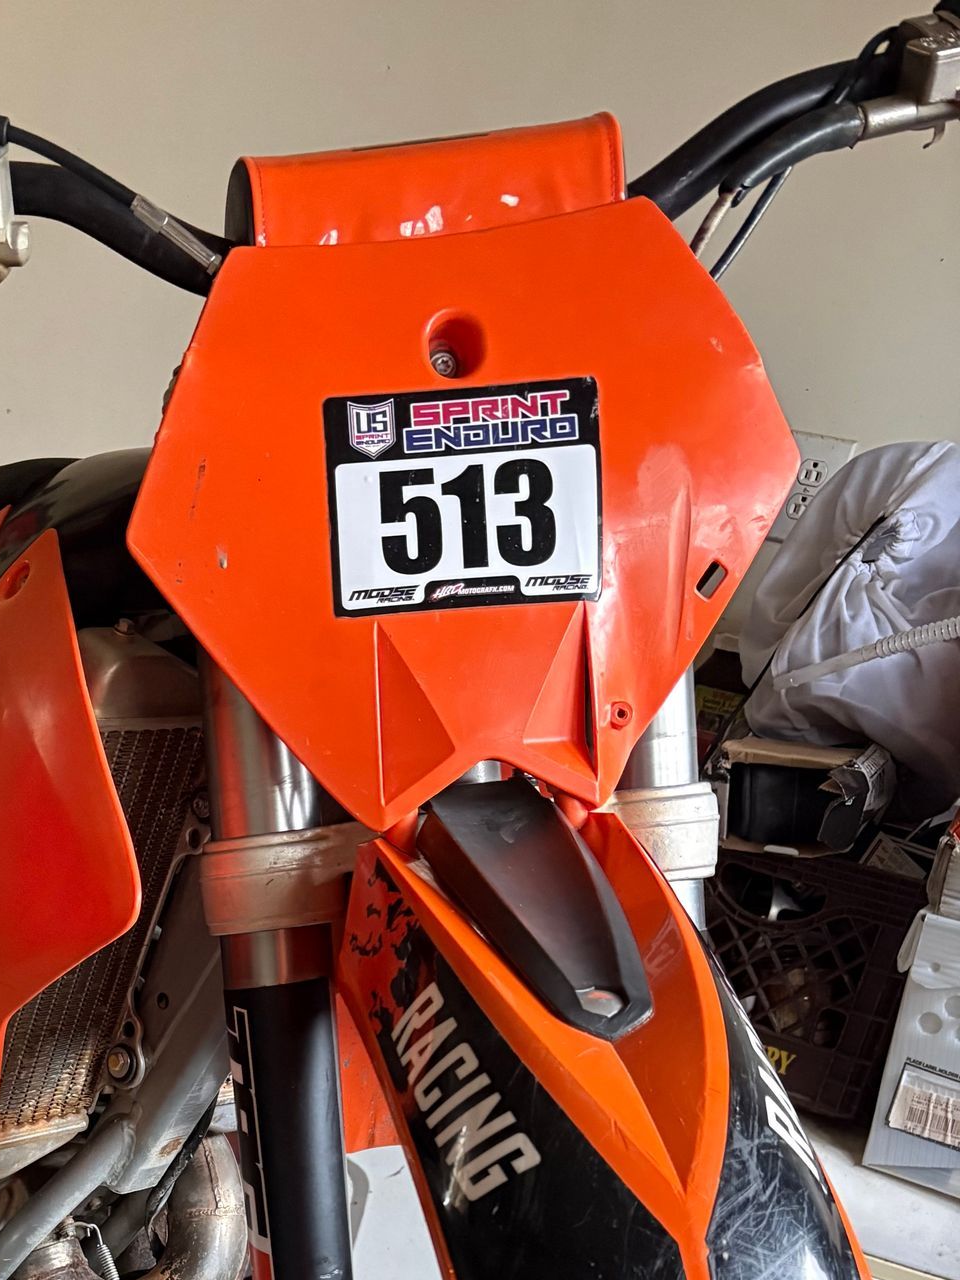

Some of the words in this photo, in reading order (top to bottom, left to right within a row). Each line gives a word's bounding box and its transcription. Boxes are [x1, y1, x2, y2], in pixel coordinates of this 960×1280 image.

[355, 410, 388, 434] US
[410, 390, 570, 428] SPRINT
[403, 414, 579, 453] ENDURO
[379, 458, 557, 575] 513
[348, 584, 421, 602] MOOSE
[525, 574, 593, 588] MOOSE
[391, 981, 541, 1202] RACING
